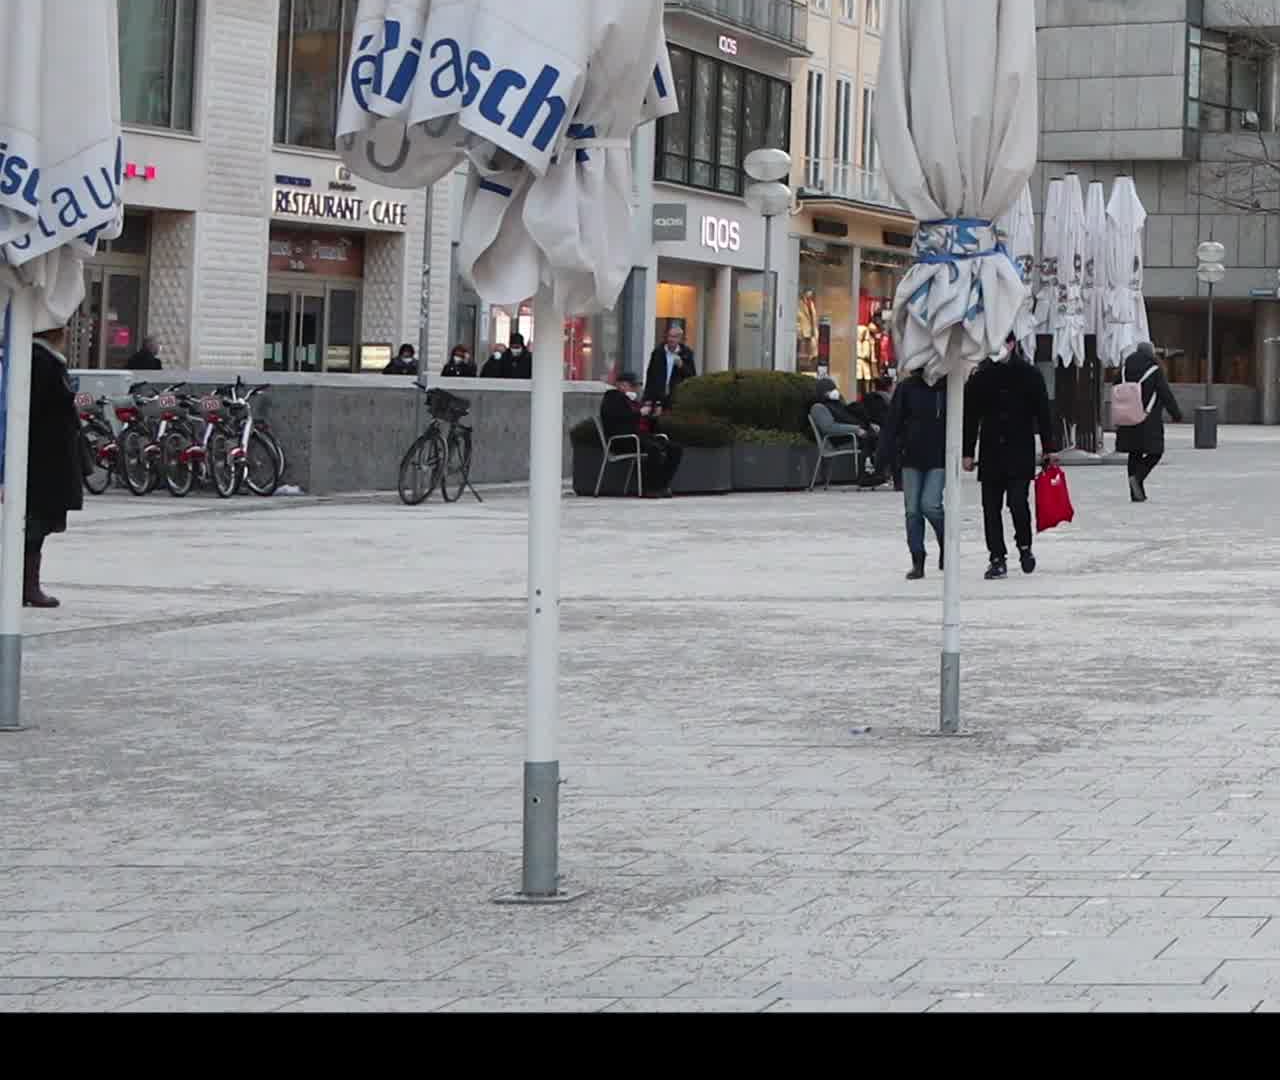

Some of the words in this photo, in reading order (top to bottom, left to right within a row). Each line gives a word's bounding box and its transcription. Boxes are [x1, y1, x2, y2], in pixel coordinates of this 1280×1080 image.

[718, 35, 739, 56] IQOS
[272, 188, 363, 221] RESTAURANT
[701, 215, 742, 254] IQOS
